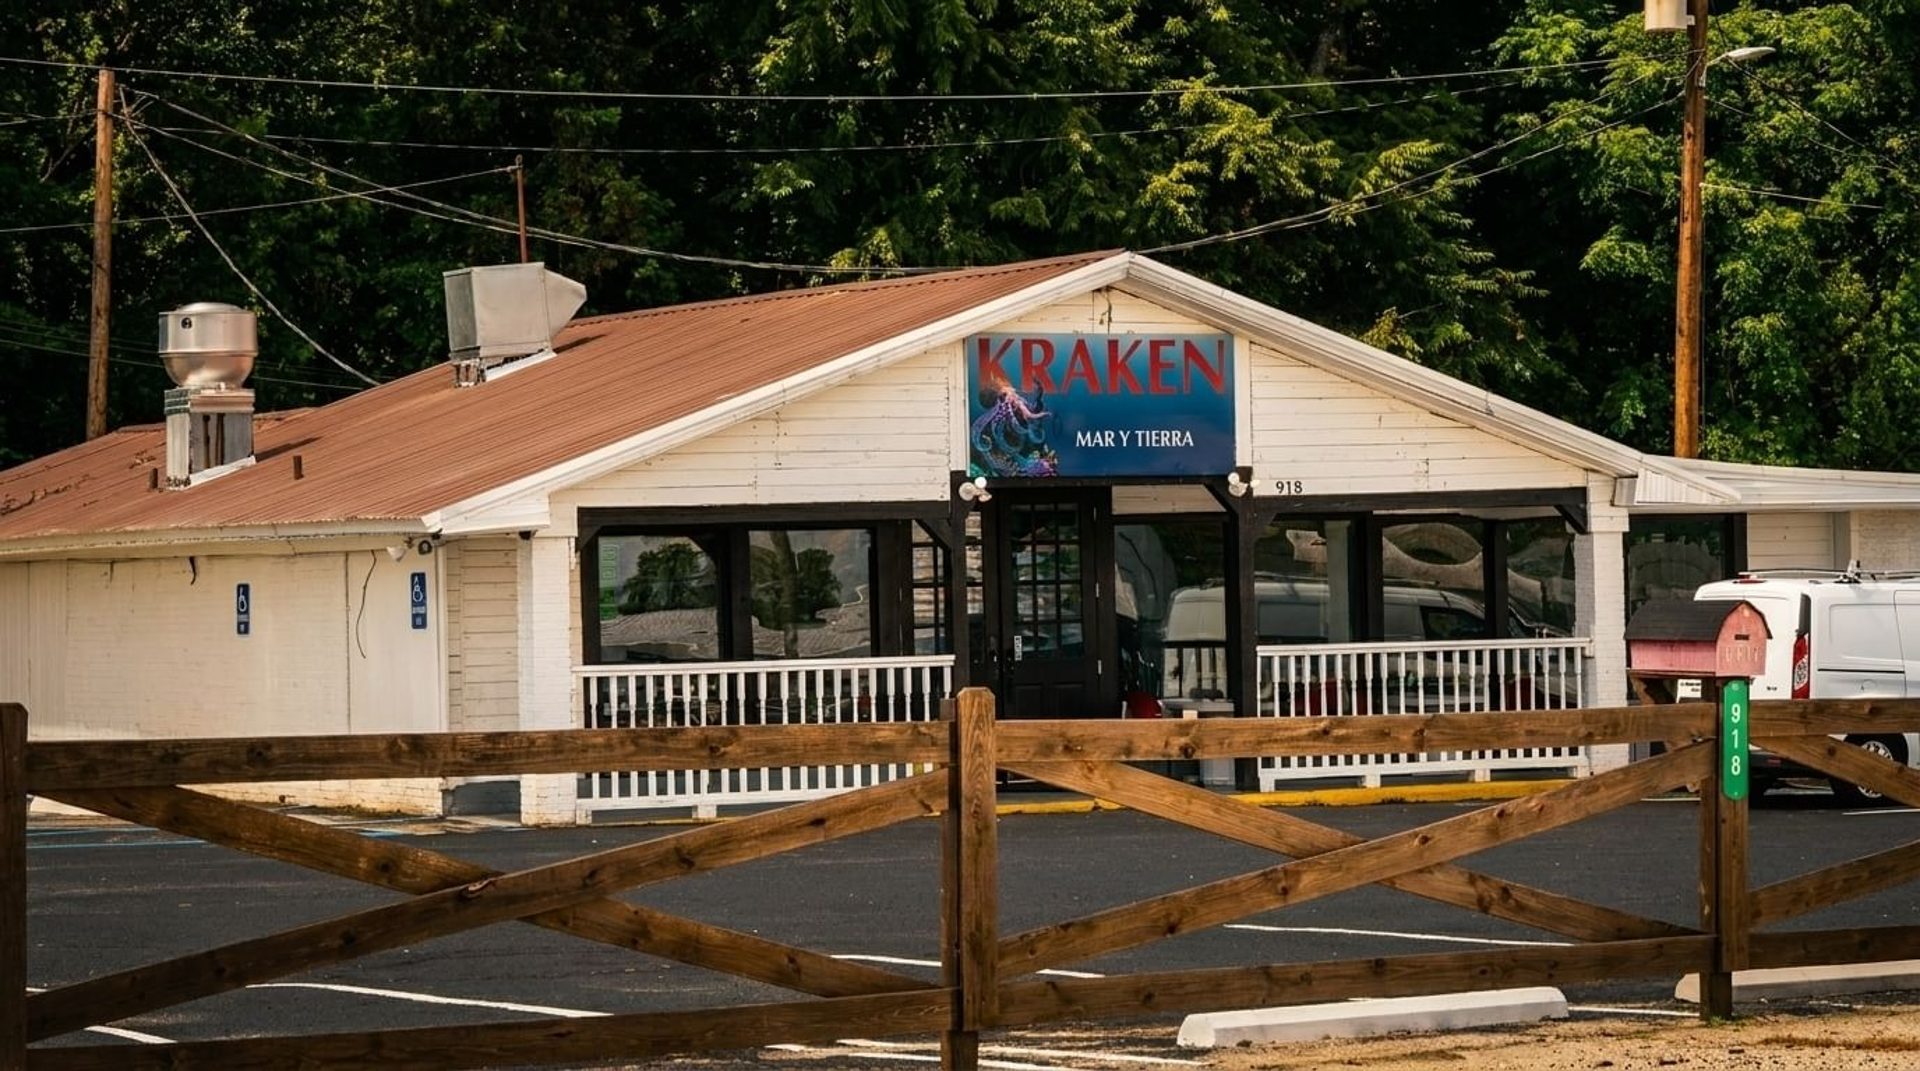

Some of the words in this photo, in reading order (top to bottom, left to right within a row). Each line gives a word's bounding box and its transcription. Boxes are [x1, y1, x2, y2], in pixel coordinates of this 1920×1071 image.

[977, 337, 1226, 395] KRAKEN
[1076, 430, 1115, 448] MAR
[1119, 430, 1131, 447] Y
[1135, 430, 1194, 447] TIERRA
[1276, 480, 1303, 495] 918
[1731, 703, 1741, 776] 918
